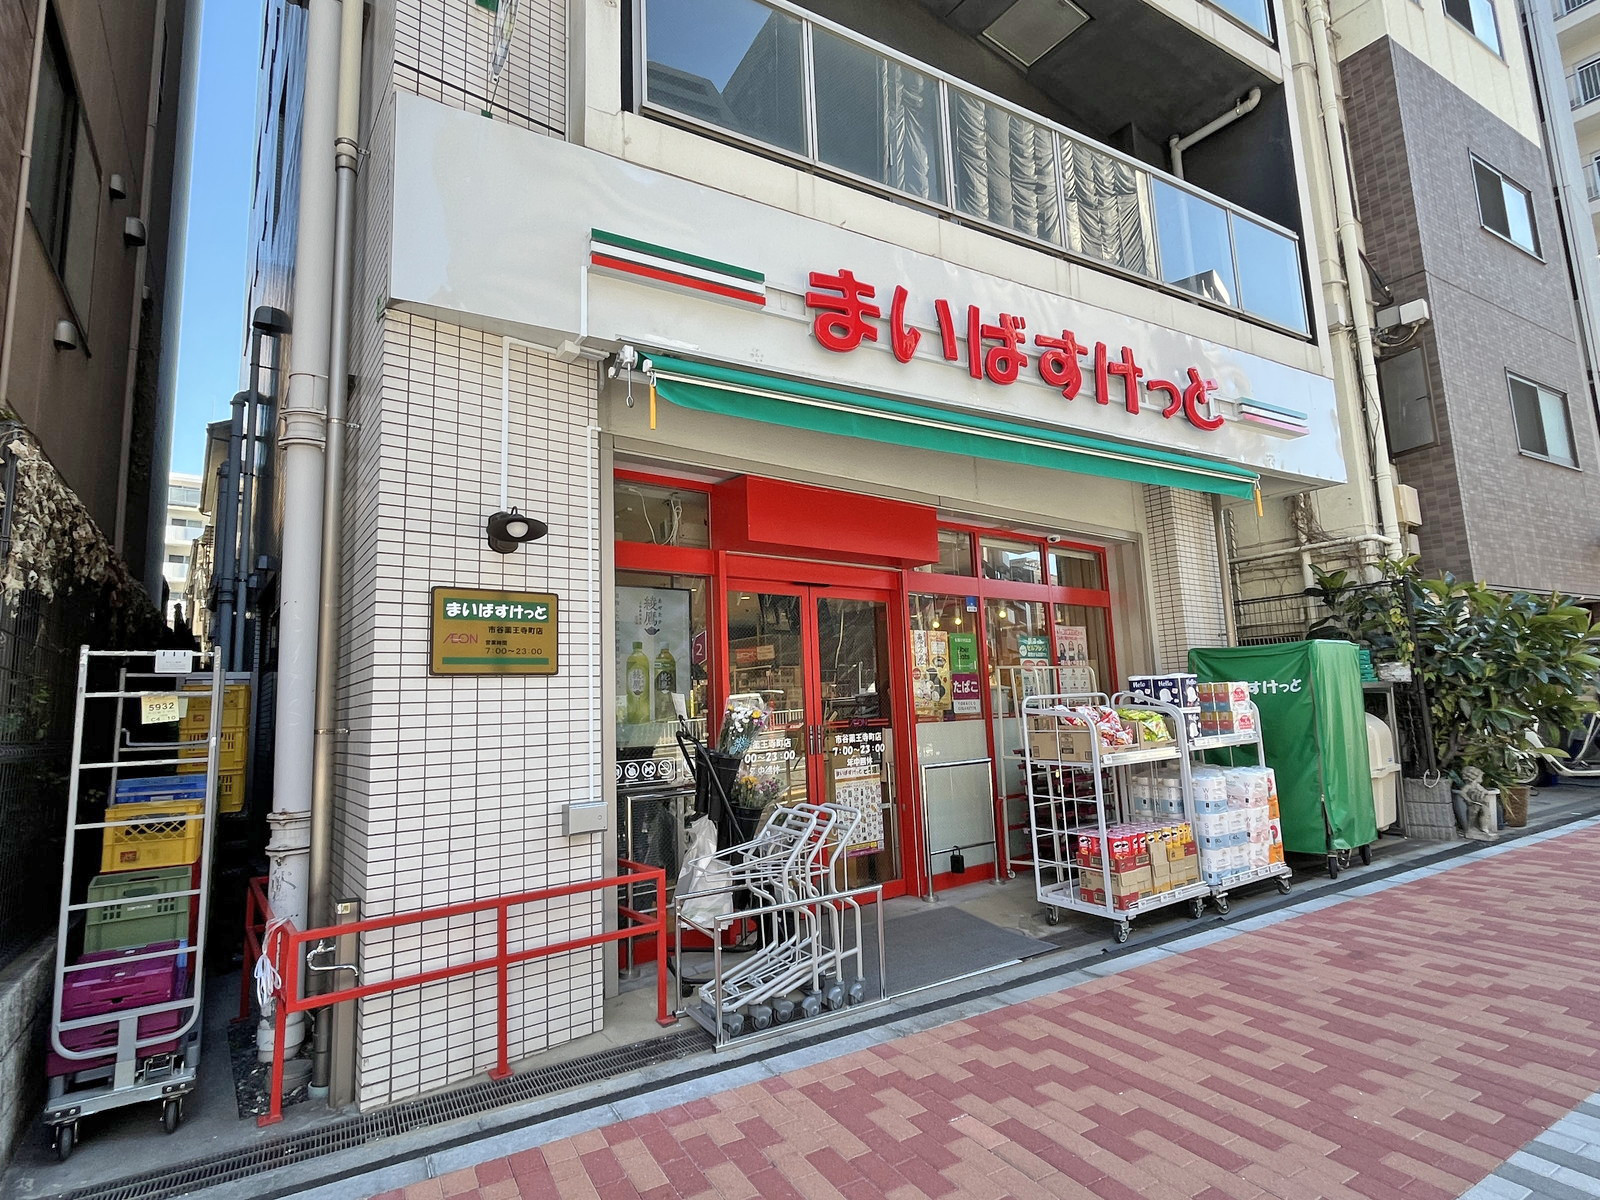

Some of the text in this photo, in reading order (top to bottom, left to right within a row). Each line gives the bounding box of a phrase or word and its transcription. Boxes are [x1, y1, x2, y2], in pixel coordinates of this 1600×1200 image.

[806, 269, 1224, 431] まいばすけっと
[446, 602, 547, 620] まいばすけっと
[696, 644, 703, 656] 2
[953, 680, 979, 694] たばこ
[149, 702, 174, 711] 5932
